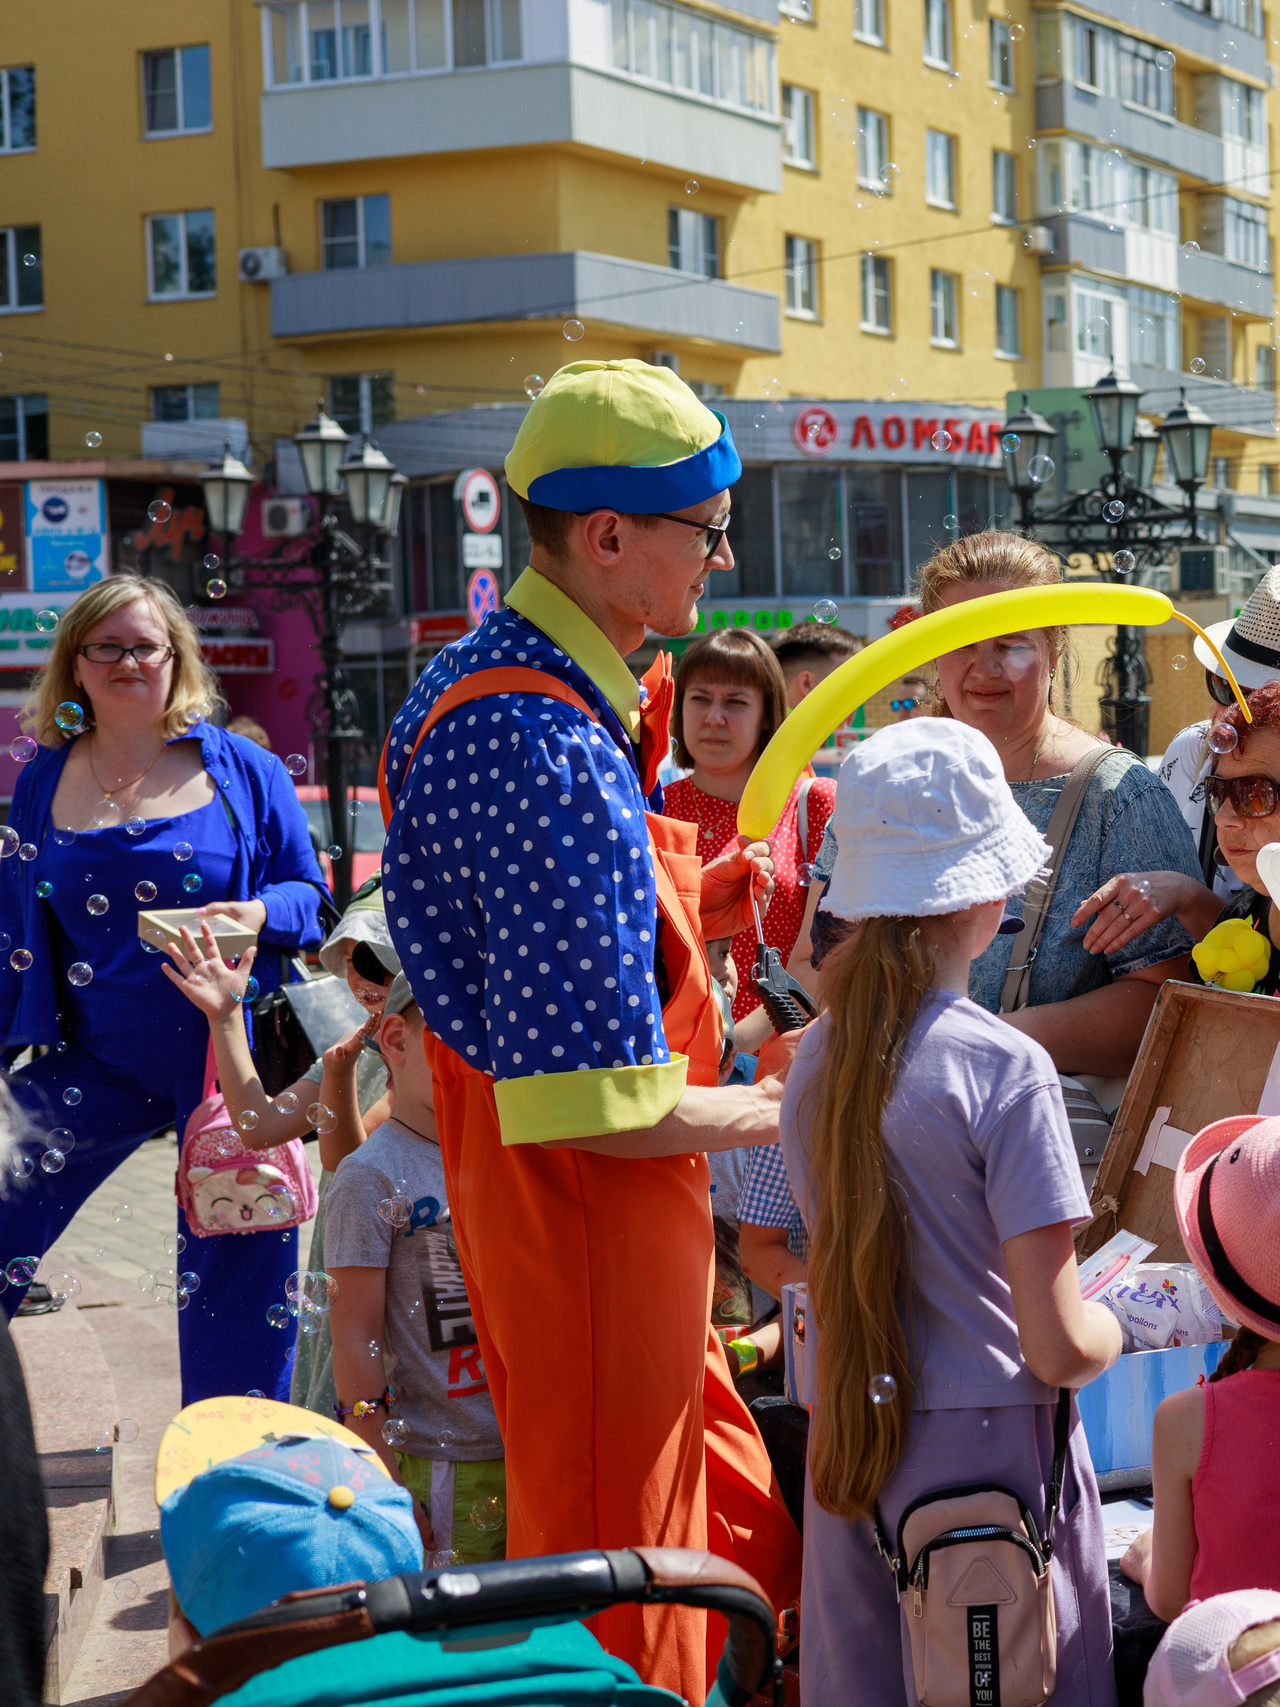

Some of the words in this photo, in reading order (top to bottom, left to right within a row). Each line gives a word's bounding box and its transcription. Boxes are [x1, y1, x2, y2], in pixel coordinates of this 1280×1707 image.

[851, 413, 1004, 455] ЛОМБАР
[972, 1621, 991, 1638] BE
[973, 1639, 992, 1651] THE
[974, 1652, 992, 1662] BEST
[974, 1671, 993, 1688] OF
[975, 1689, 993, 1701] YOU
